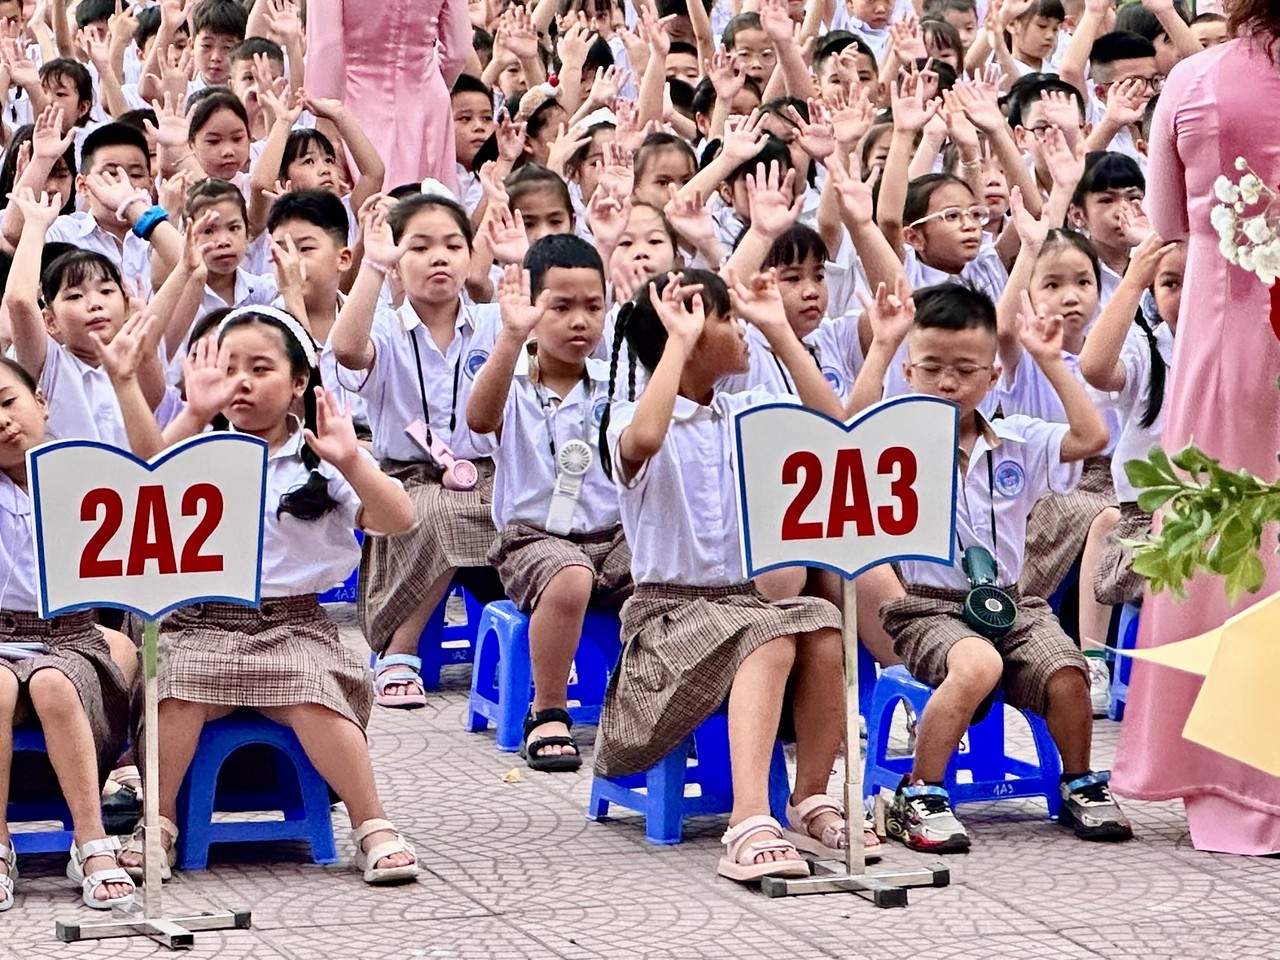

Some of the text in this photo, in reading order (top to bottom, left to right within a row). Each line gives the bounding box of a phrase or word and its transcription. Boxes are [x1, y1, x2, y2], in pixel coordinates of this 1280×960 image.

[79, 483, 224, 579] 2A2
[781, 446, 919, 541] 2A3
[993, 783, 1014, 796] 1A3
